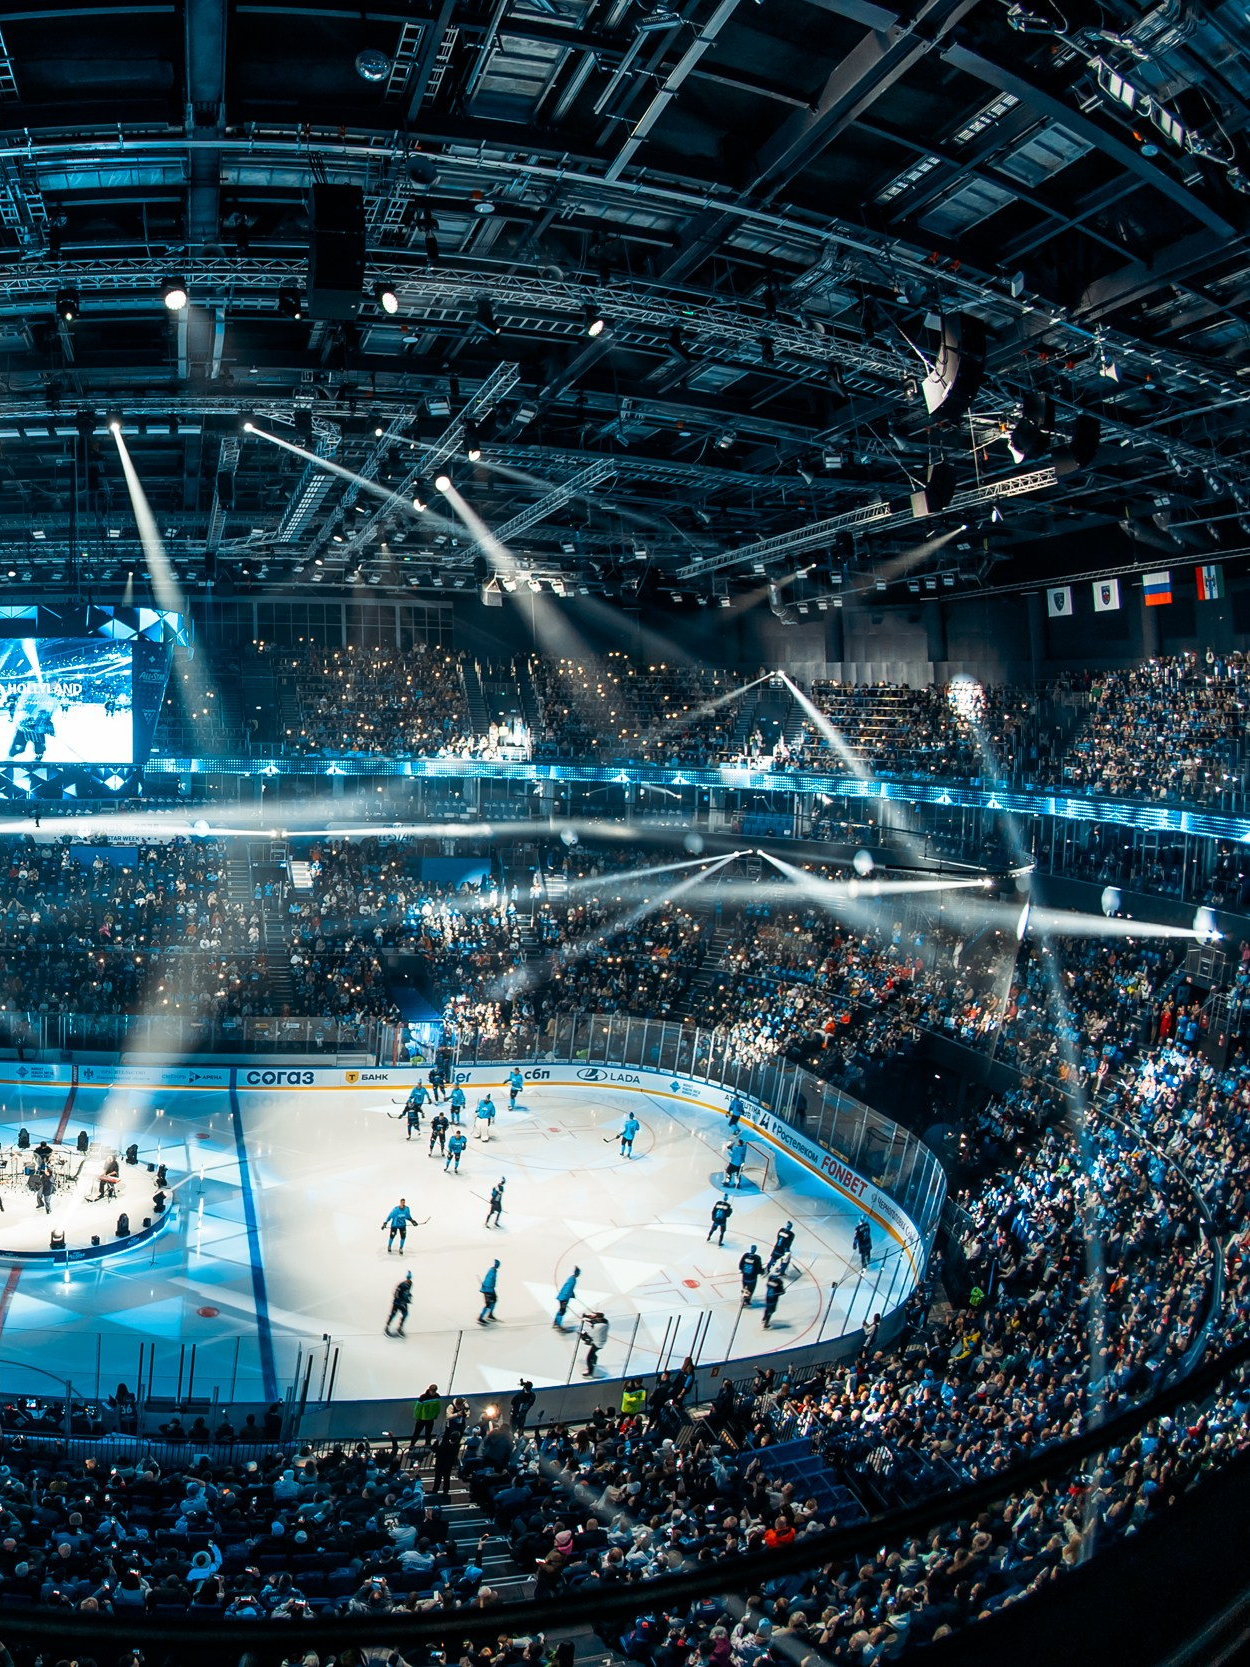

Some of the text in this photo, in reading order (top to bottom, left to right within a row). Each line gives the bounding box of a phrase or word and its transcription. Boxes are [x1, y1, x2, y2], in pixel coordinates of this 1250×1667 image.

[8, 683, 83, 696] HOLLYLAND
[361, 1073, 389, 1081] БАНК
[524, 1068, 550, 1080] сбп
[610, 1072, 640, 1084] LADA
[776, 1124, 819, 1164] Ростелеком
[820, 1155, 869, 1198] FONBET
[120, 1403, 133, 1415] 36
